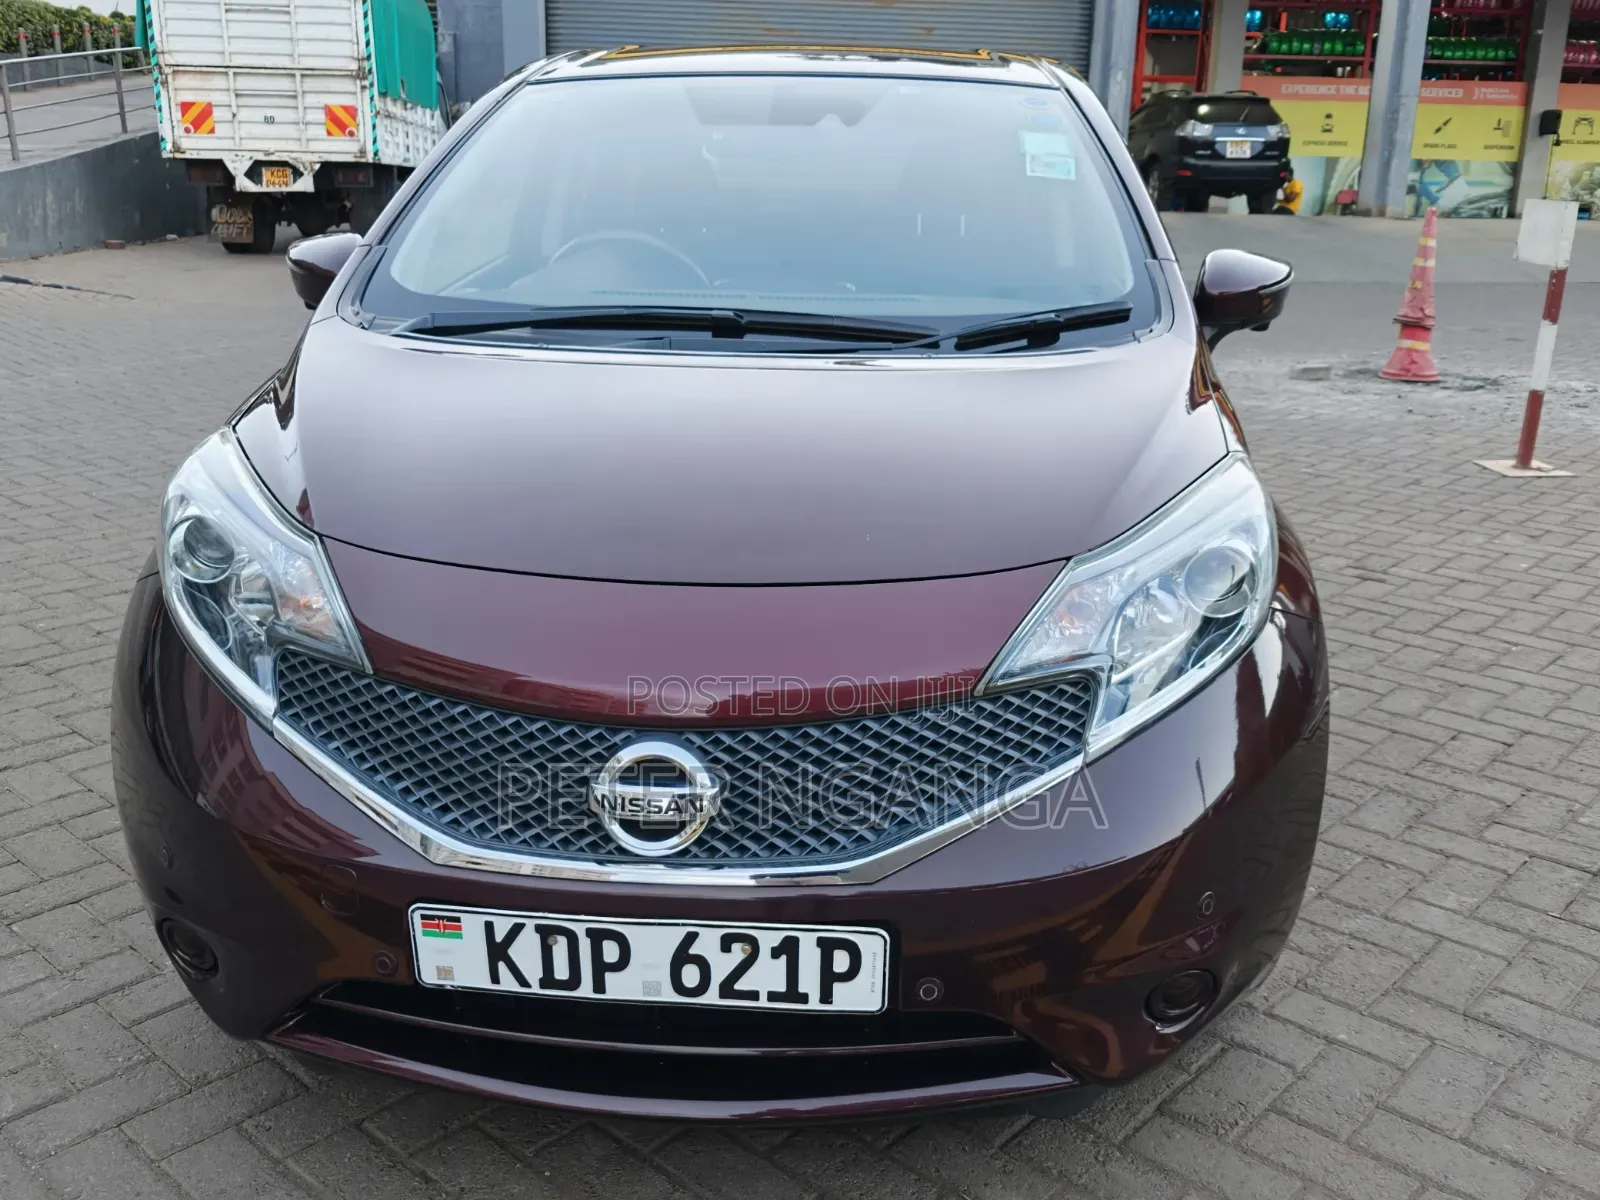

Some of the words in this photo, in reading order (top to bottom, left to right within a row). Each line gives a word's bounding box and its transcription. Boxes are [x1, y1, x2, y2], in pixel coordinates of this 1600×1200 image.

[1338, 85, 1356, 95] THE
[1420, 87, 1464, 98] SERVICES
[271, 168, 288, 179] KCG
[600, 793, 704, 815] NISSAN
[484, 919, 632, 995] KDP
[669, 930, 863, 1005] 621P
